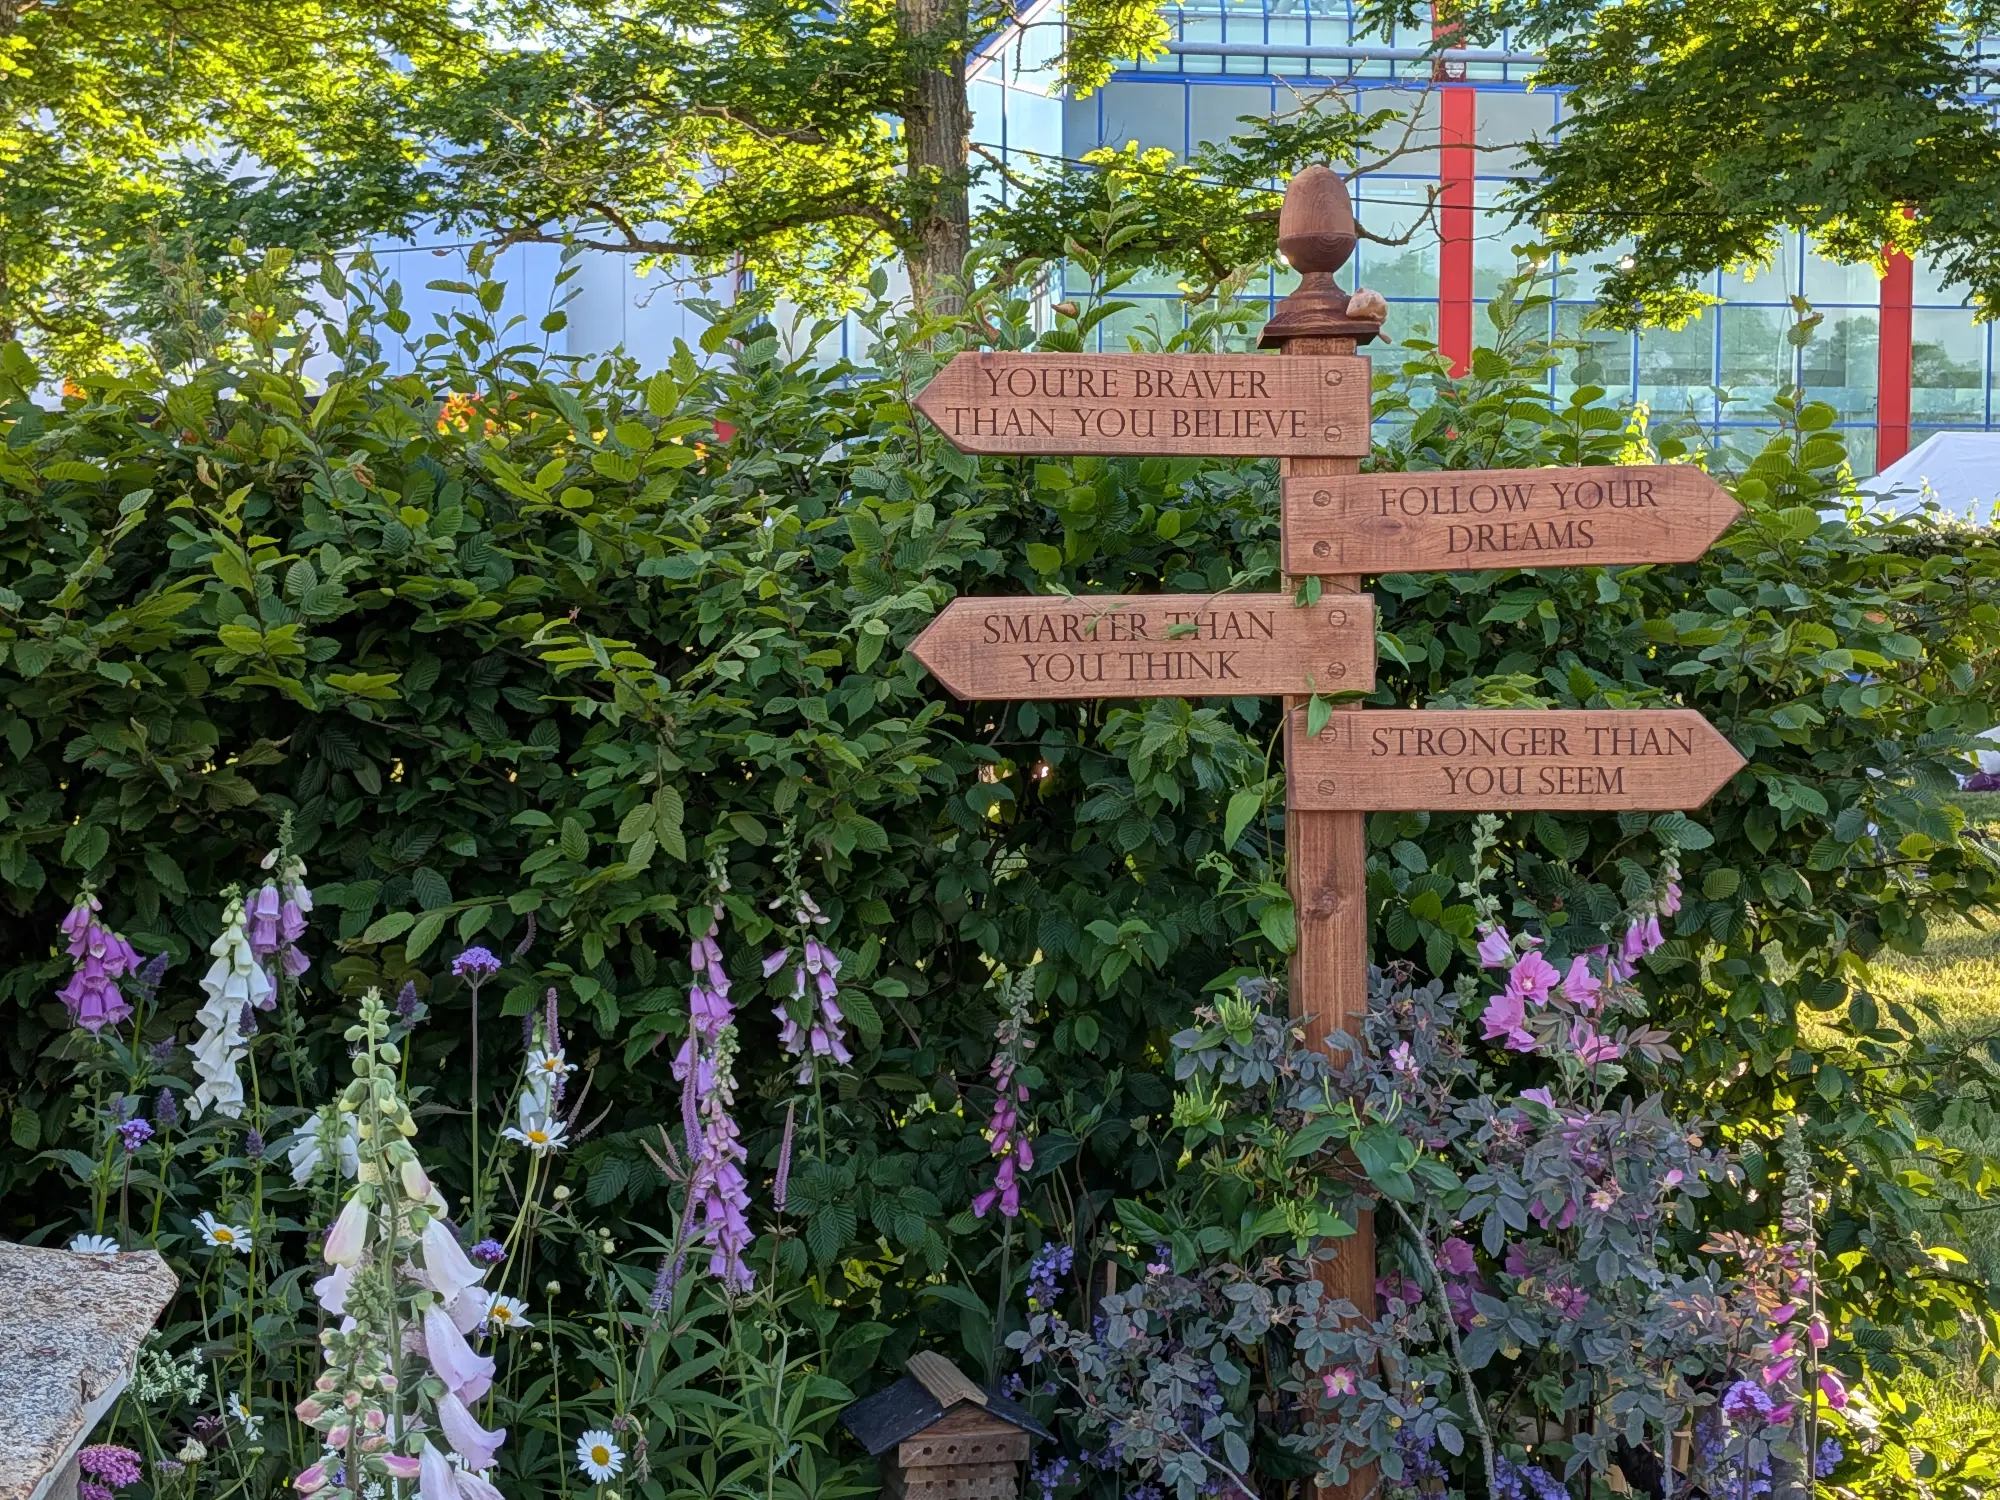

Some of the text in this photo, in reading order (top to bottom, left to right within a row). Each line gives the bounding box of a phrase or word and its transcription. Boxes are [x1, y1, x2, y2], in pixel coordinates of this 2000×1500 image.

[982, 366, 1272, 399] YOU'RE BRAVER
[945, 407, 1308, 438] THAN YOU BELIEVE
[1380, 478, 1658, 516] FOLLOW YOUR
[1447, 519, 1594, 554] DREAMS
[983, 610, 1274, 644] SMARTER THAN
[1022, 650, 1242, 683] YOU THINK
[1371, 727, 1695, 757] STRONGER THAN
[1441, 765, 1625, 795] YOU SEEM
